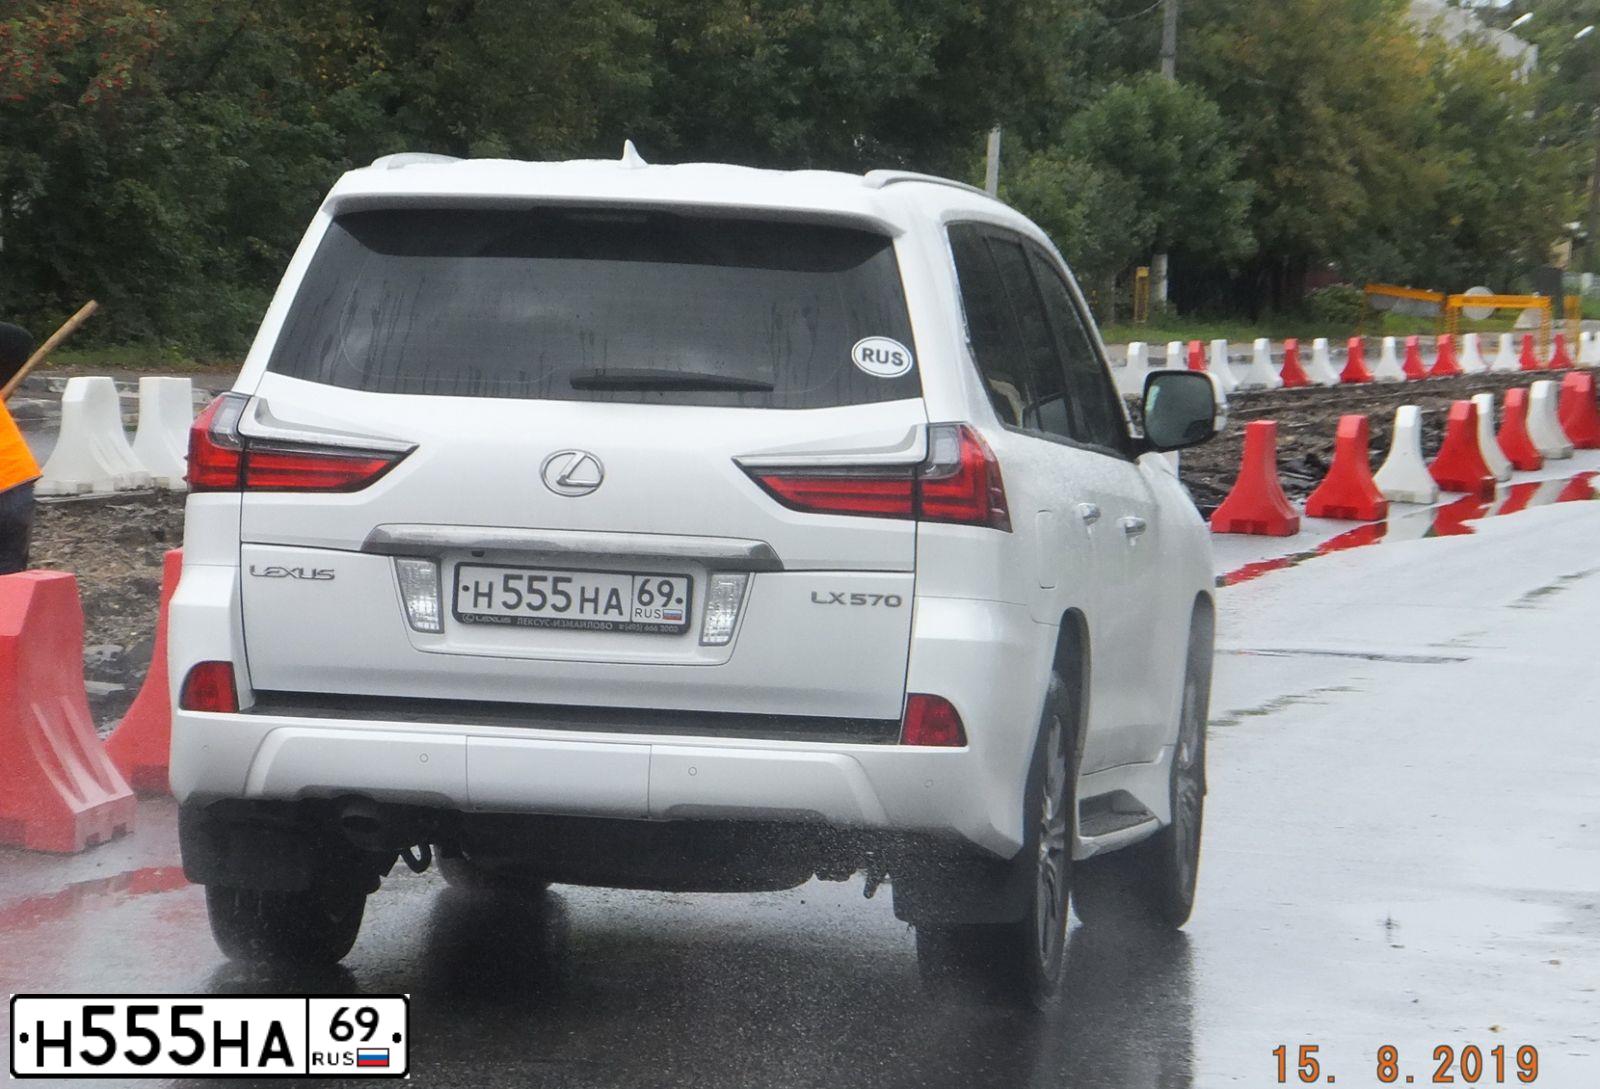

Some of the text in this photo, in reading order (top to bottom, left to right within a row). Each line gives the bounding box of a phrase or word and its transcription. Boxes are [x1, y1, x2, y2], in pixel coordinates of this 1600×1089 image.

[862, 347, 903, 366] RUS
[249, 565, 335, 580] LEXUS
[637, 579, 675, 607] 69
[635, 607, 661, 619] RUS
